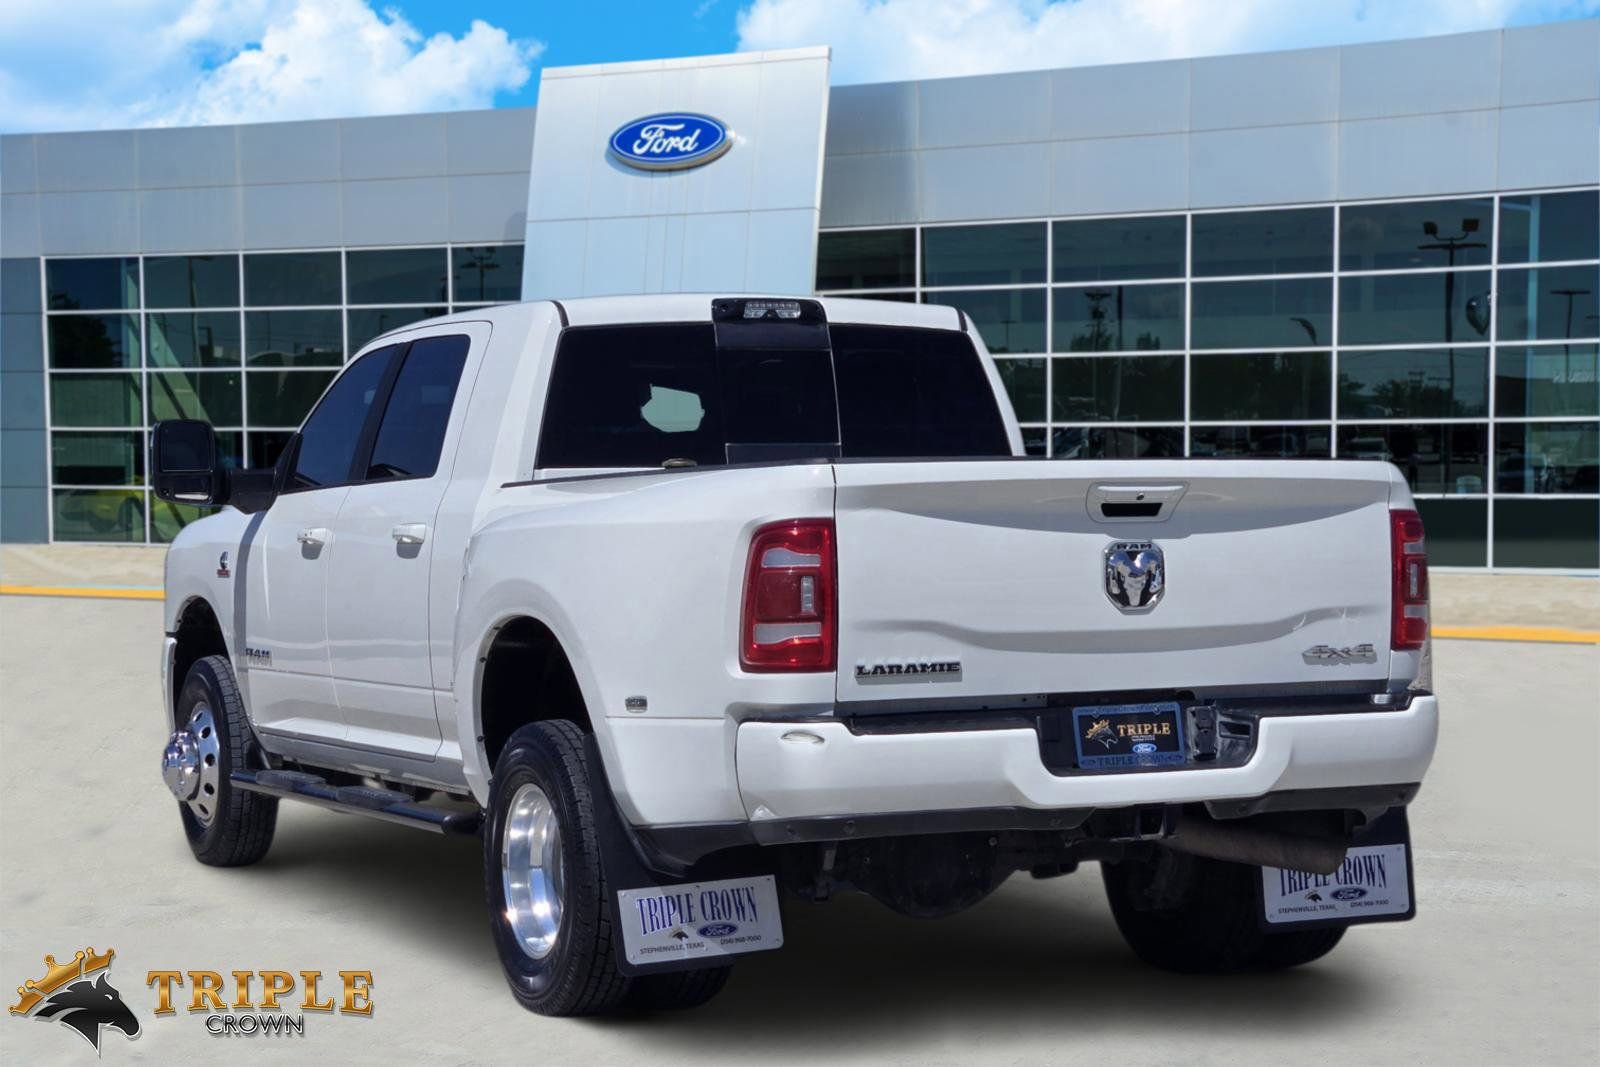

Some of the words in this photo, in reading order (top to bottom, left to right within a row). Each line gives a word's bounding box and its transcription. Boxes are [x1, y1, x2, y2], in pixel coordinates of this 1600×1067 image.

[632, 123, 702, 155] Ford
[856, 662, 961, 676] LARAMIE
[1116, 722, 1171, 736] TRIPLE
[1335, 854, 1387, 888] CROWN
[636, 893, 696, 935] TRIPLE
[700, 886, 759, 923] CROWN
[686, 942, 705, 950] TEXAS
